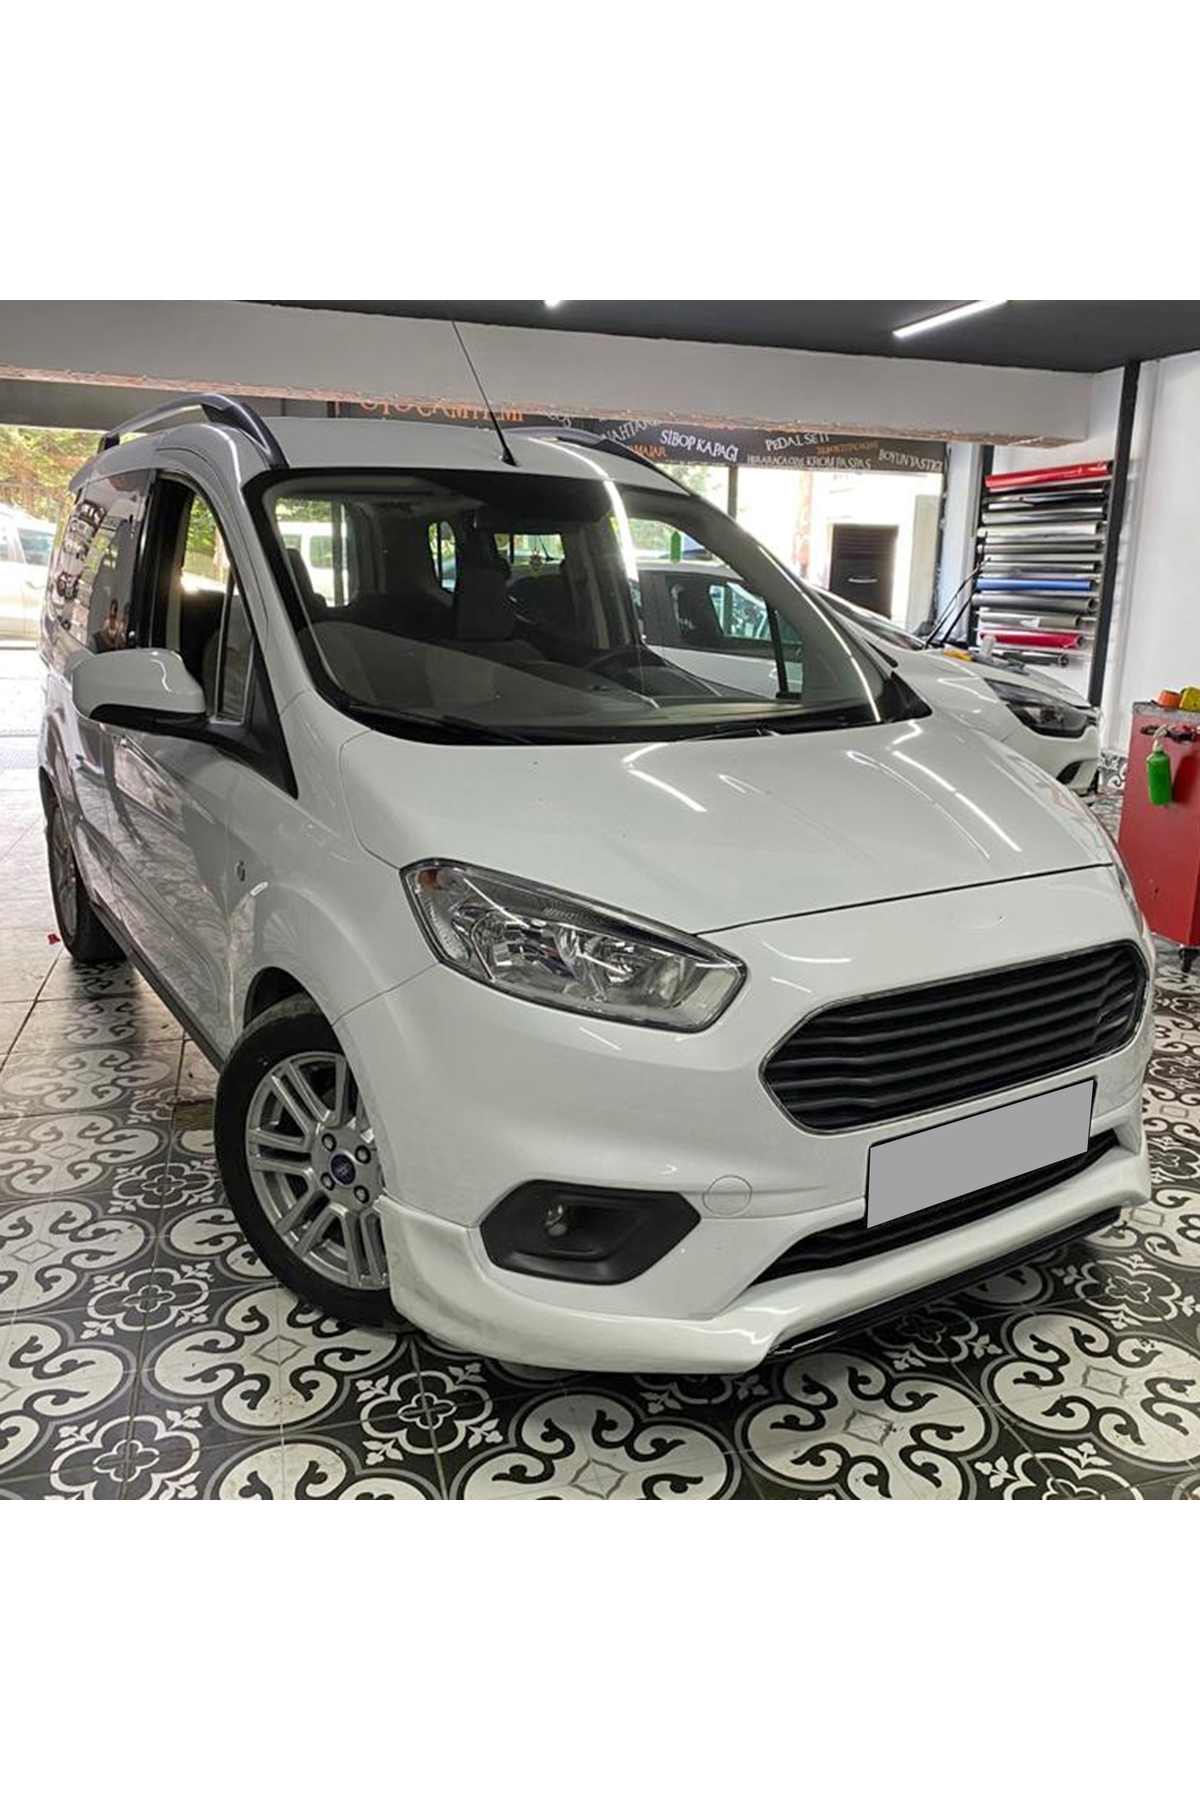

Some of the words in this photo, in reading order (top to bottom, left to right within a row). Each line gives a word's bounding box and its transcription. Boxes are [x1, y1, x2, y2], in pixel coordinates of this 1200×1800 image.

[765, 434, 804, 451] PEDAL
[806, 456, 835, 467] KROM
[836, 457, 872, 469] PASPAS
